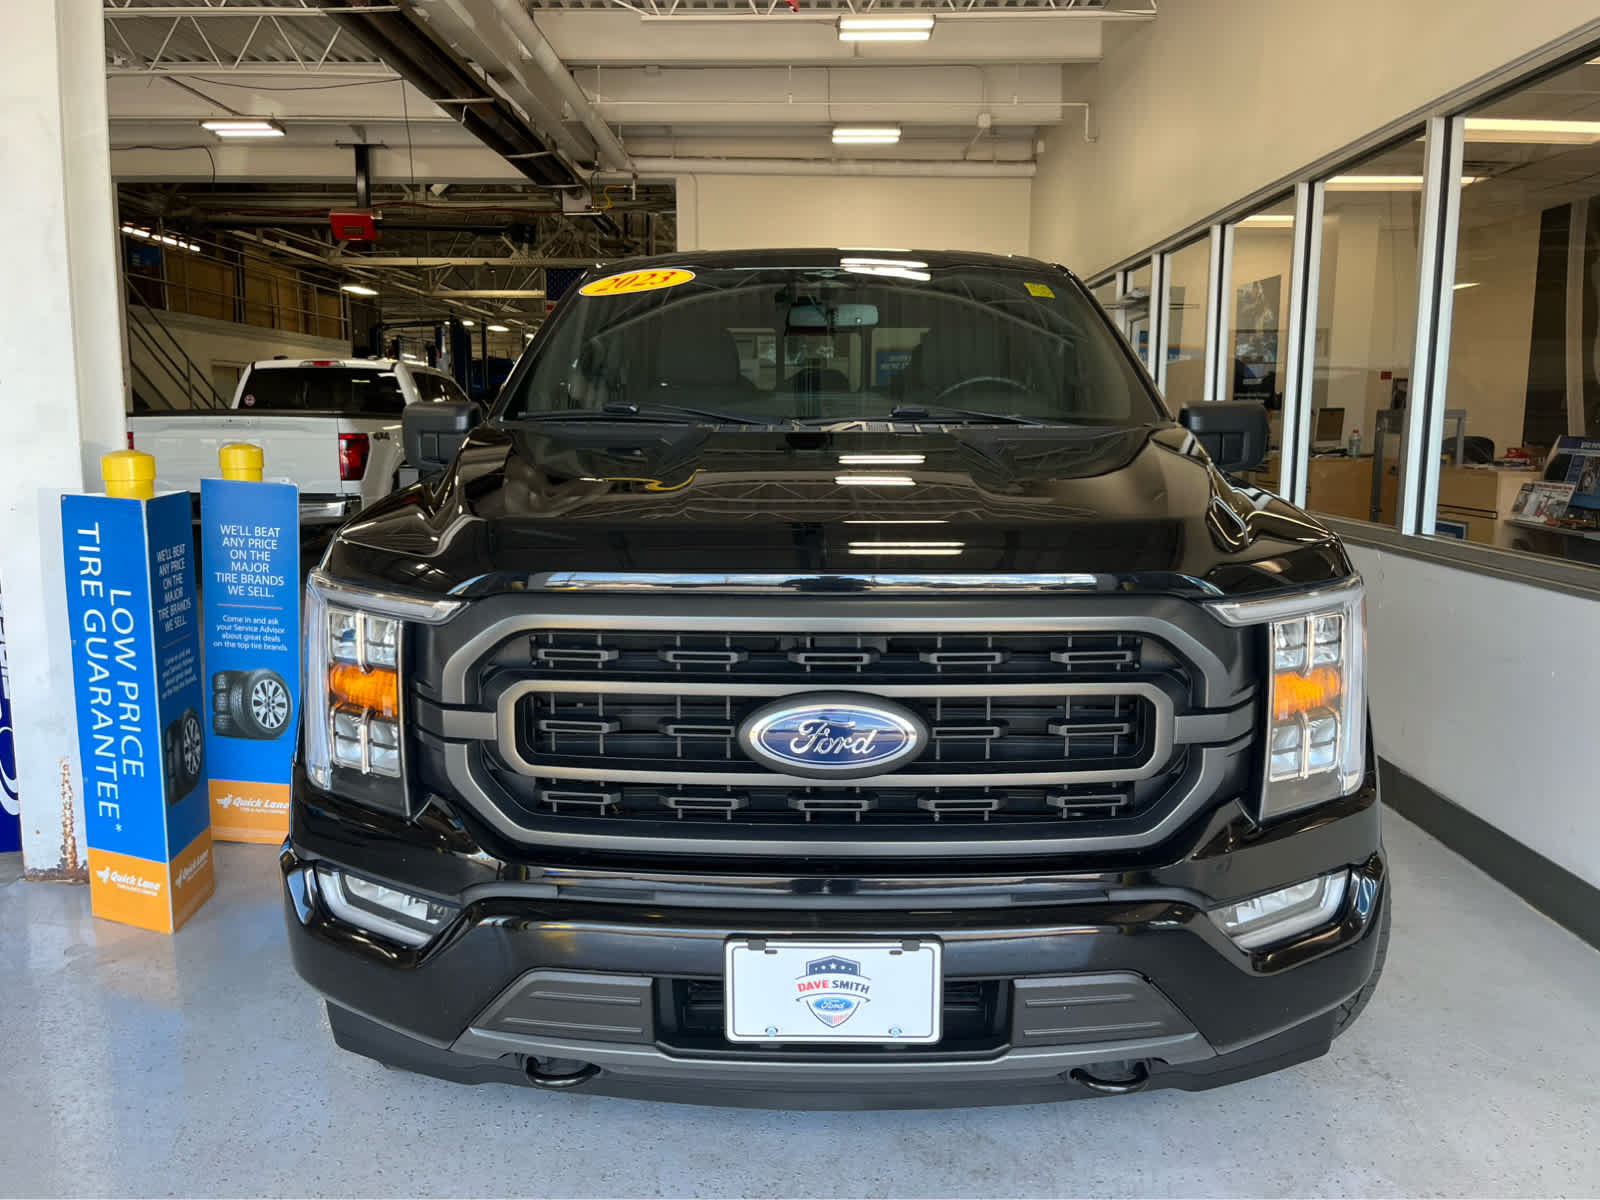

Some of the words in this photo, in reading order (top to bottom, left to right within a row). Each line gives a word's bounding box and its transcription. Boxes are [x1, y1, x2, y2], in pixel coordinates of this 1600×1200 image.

[220, 524, 251, 536] WE'LL
[254, 526, 281, 537] BEAT
[222, 537, 245, 548] ANY
[248, 538, 278, 550] PRICE
[77, 522, 104, 598] TIRE
[230, 549, 247, 560] ON
[250, 550, 271, 562] THE
[171, 557, 186, 572] PRICE
[231, 561, 270, 573] MAJOR
[173, 573, 184, 586] THE
[215, 572, 238, 583] TIRE
[241, 573, 285, 586] BRANDS
[227, 585, 245, 596] WE
[247, 585, 275, 598] SELL.
[222, 614, 243, 623] Come
[110, 589, 137, 671] LOW
[233, 624, 258, 632] Service
[222, 632, 242, 640] about
[224, 640, 236, 648] the
[117, 681, 144, 777] PRICE
[790, 719, 877, 754] Ford
[233, 797, 262, 807] Quick
[110, 870, 137, 885] Quick
[137, 876, 161, 891] Lane
[797, 979, 830, 992] DAVE
[832, 979, 870, 994] SMITH
[820, 999, 846, 1009] Ford
